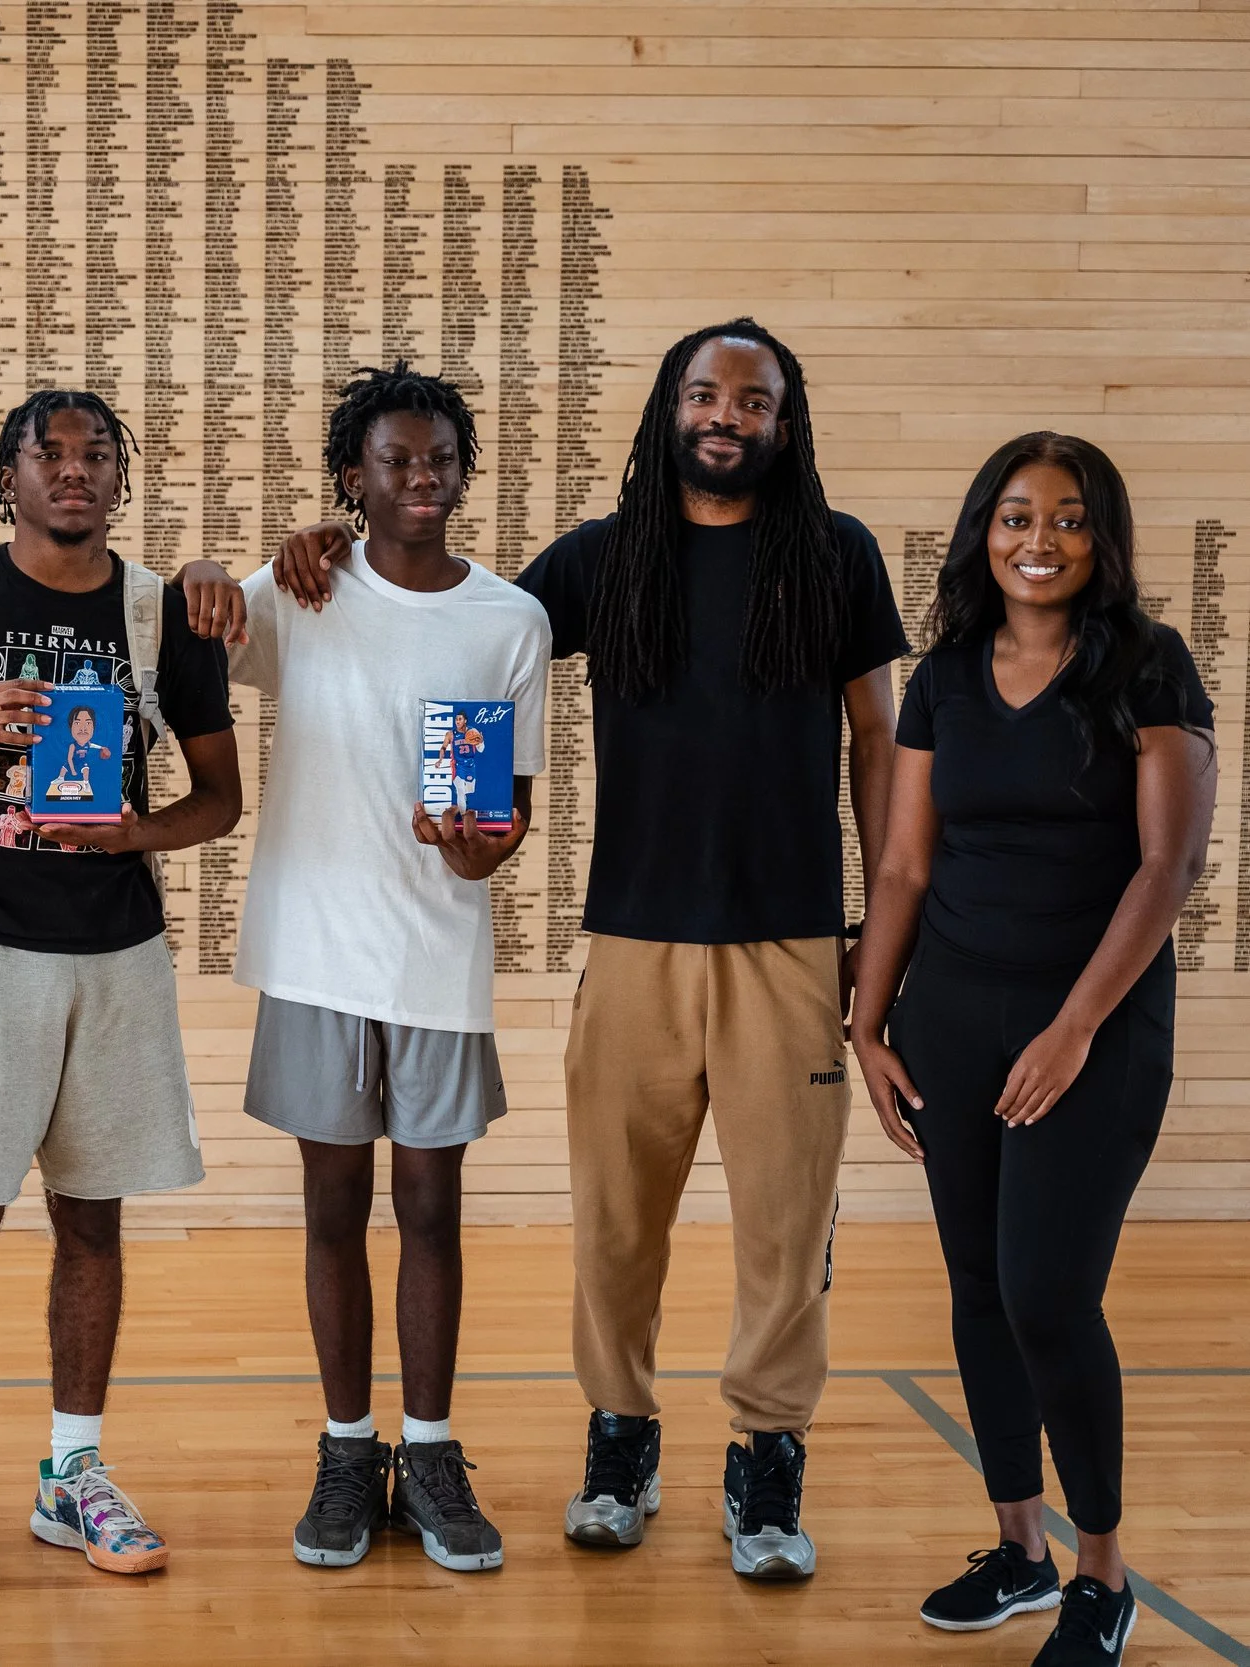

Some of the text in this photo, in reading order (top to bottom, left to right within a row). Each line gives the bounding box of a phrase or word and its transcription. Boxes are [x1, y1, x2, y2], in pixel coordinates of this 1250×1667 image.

[52, 625, 74, 636] MARVEL
[6, 631, 117, 654] ETERNALS
[423, 702, 454, 824] ADEN IVEY
[810, 1070, 845, 1085] PUMA
